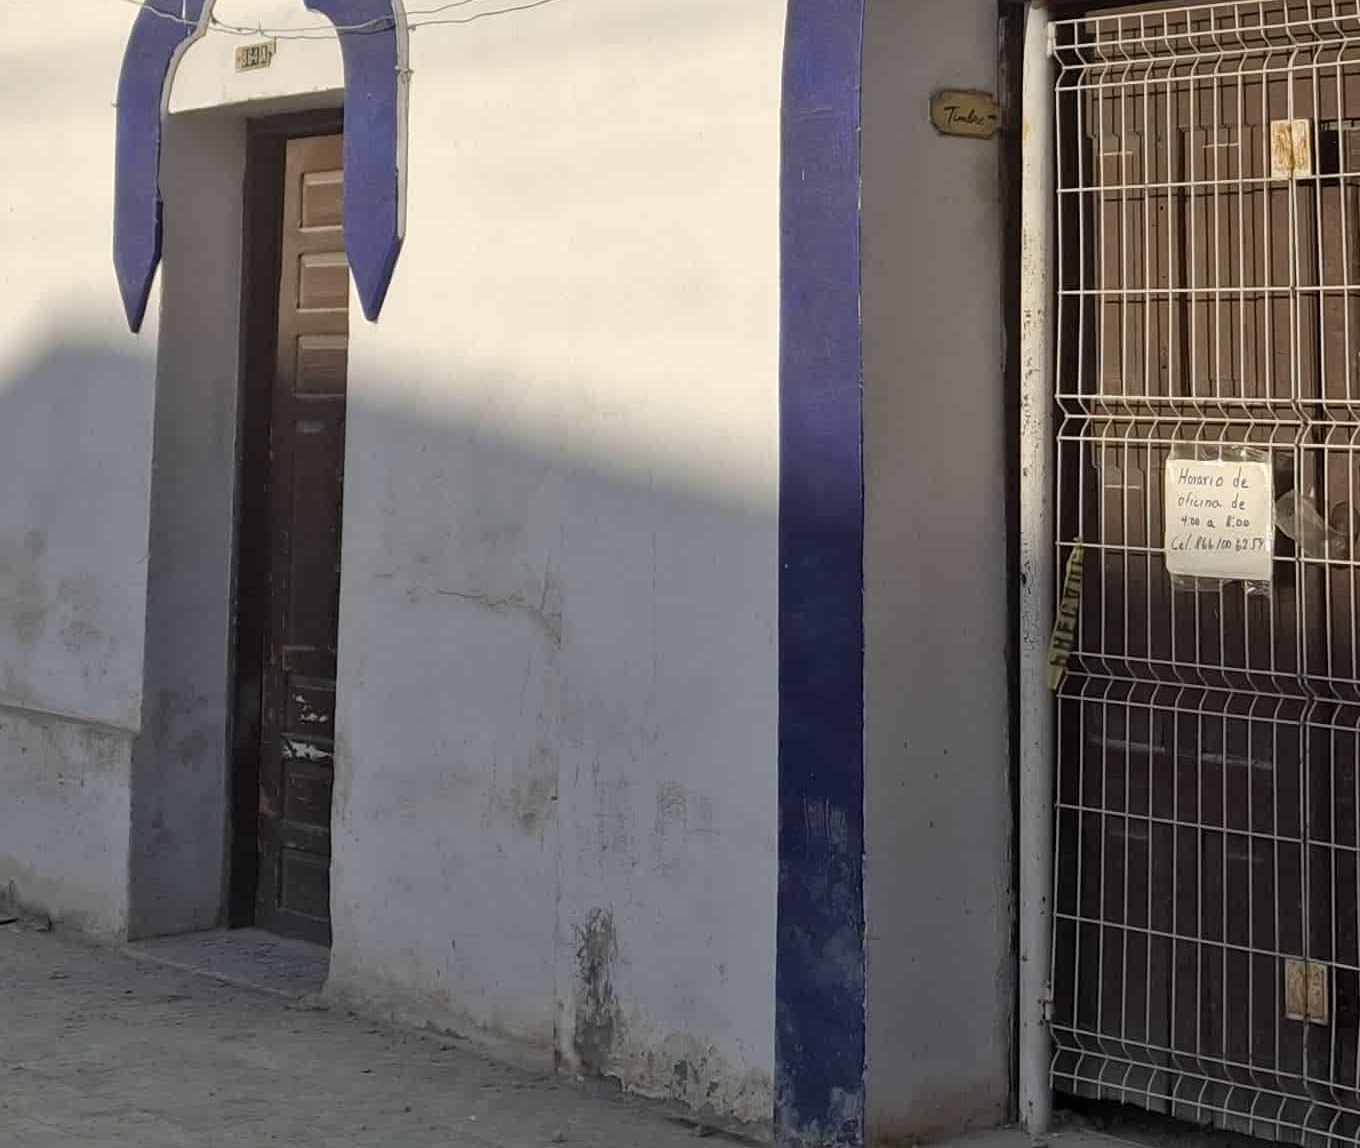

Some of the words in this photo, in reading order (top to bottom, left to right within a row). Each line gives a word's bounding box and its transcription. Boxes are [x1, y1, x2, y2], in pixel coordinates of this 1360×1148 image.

[1178, 468, 1223, 487] Horario
[1232, 467, 1249, 489] de
[1177, 492, 1222, 508] oficina
[1231, 493, 1246, 510] de
[1207, 519, 1216, 529] a
